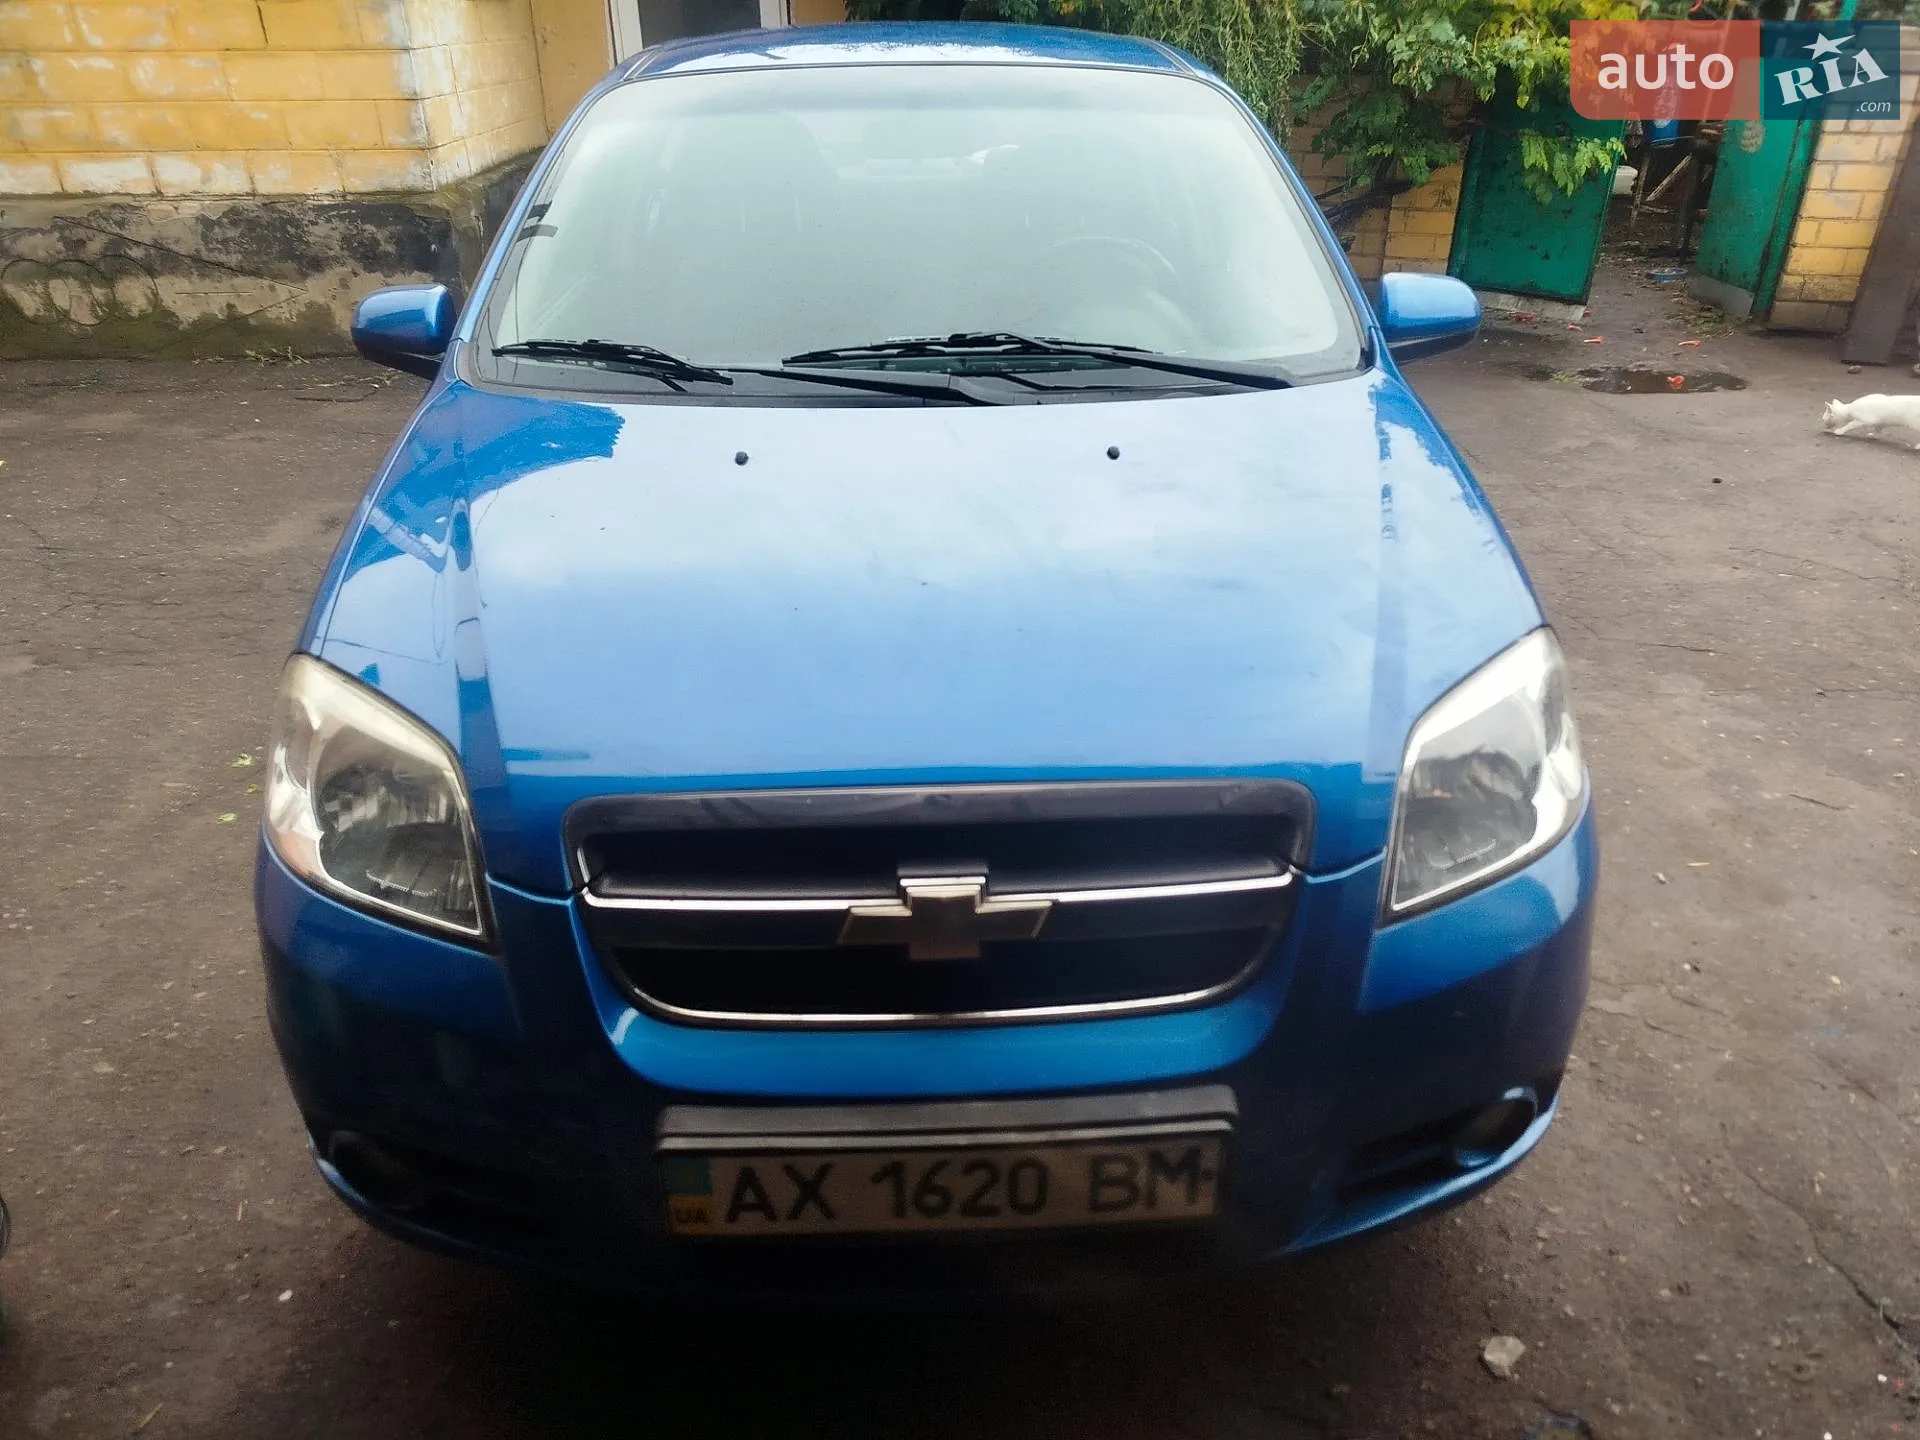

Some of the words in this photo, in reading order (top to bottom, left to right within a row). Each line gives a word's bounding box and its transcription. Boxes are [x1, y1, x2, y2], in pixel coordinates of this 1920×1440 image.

[727, 1163, 835, 1222] AX
[871, 1158, 1048, 1219] 1620
[1089, 1147, 1201, 1212] BM
[674, 1207, 709, 1224] UA
